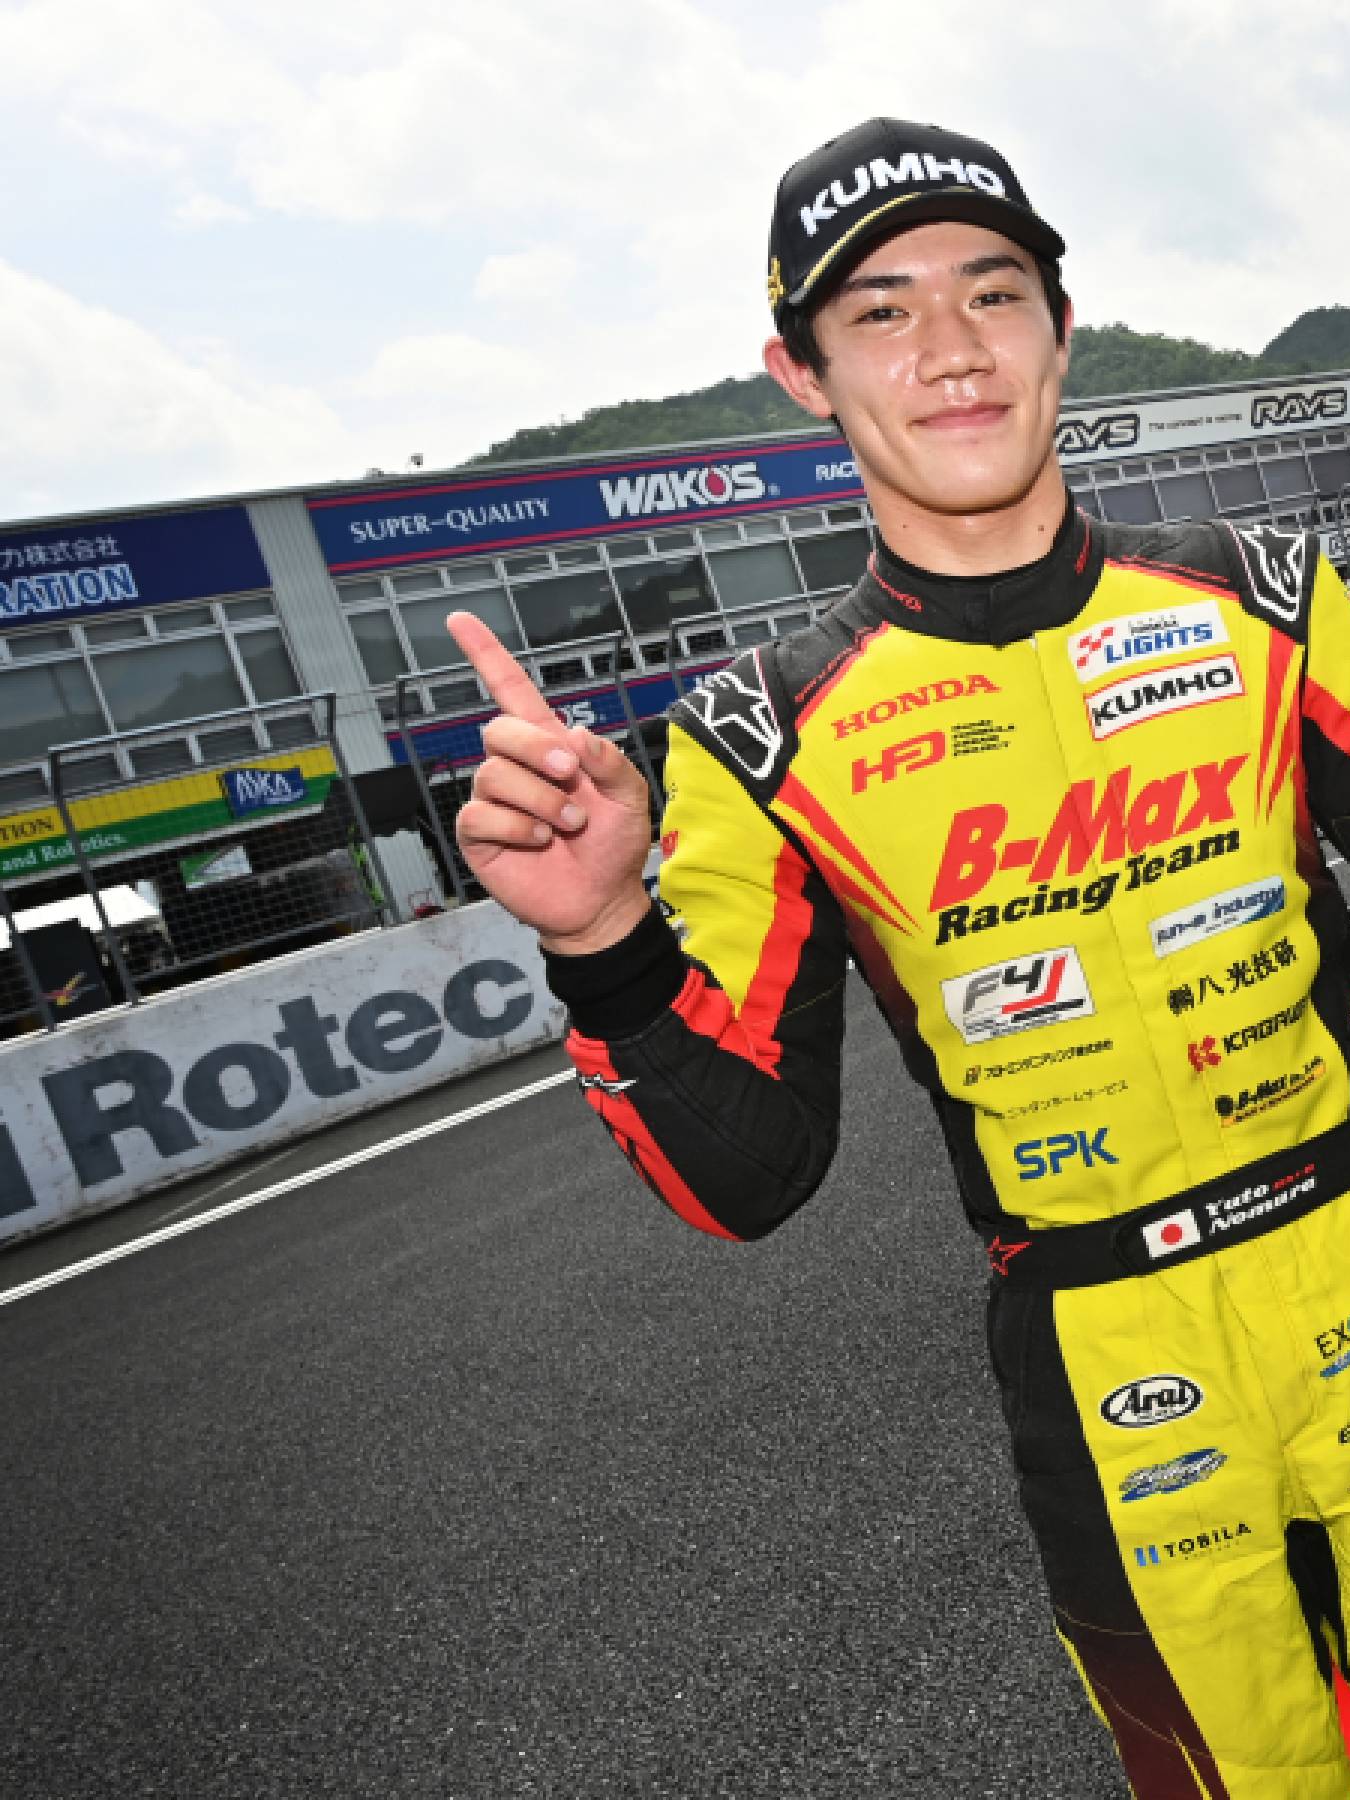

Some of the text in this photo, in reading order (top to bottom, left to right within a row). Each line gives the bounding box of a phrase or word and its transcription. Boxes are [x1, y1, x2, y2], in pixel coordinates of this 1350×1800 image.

[800, 153, 1007, 236] KUMHO
[1251, 388, 1347, 427] RAYS
[1056, 414, 1140, 454] AYS
[348, 497, 551, 544] SUPER-QUALITY
[1104, 623, 1213, 664] LIGHTS
[830, 675, 1001, 740] HONDA
[1091, 666, 1234, 726] KUMHO
[929, 753, 1250, 912] B-Max
[935, 830, 1238, 945] Racing Team
[1013, 1127, 1120, 1181] SPK
[1206, 1183, 1269, 1216] Yuto
[1208, 1175, 1316, 1236] Nomura
[1113, 1383, 1200, 1419] Arai
[1163, 1521, 1253, 1558] TOBILA
